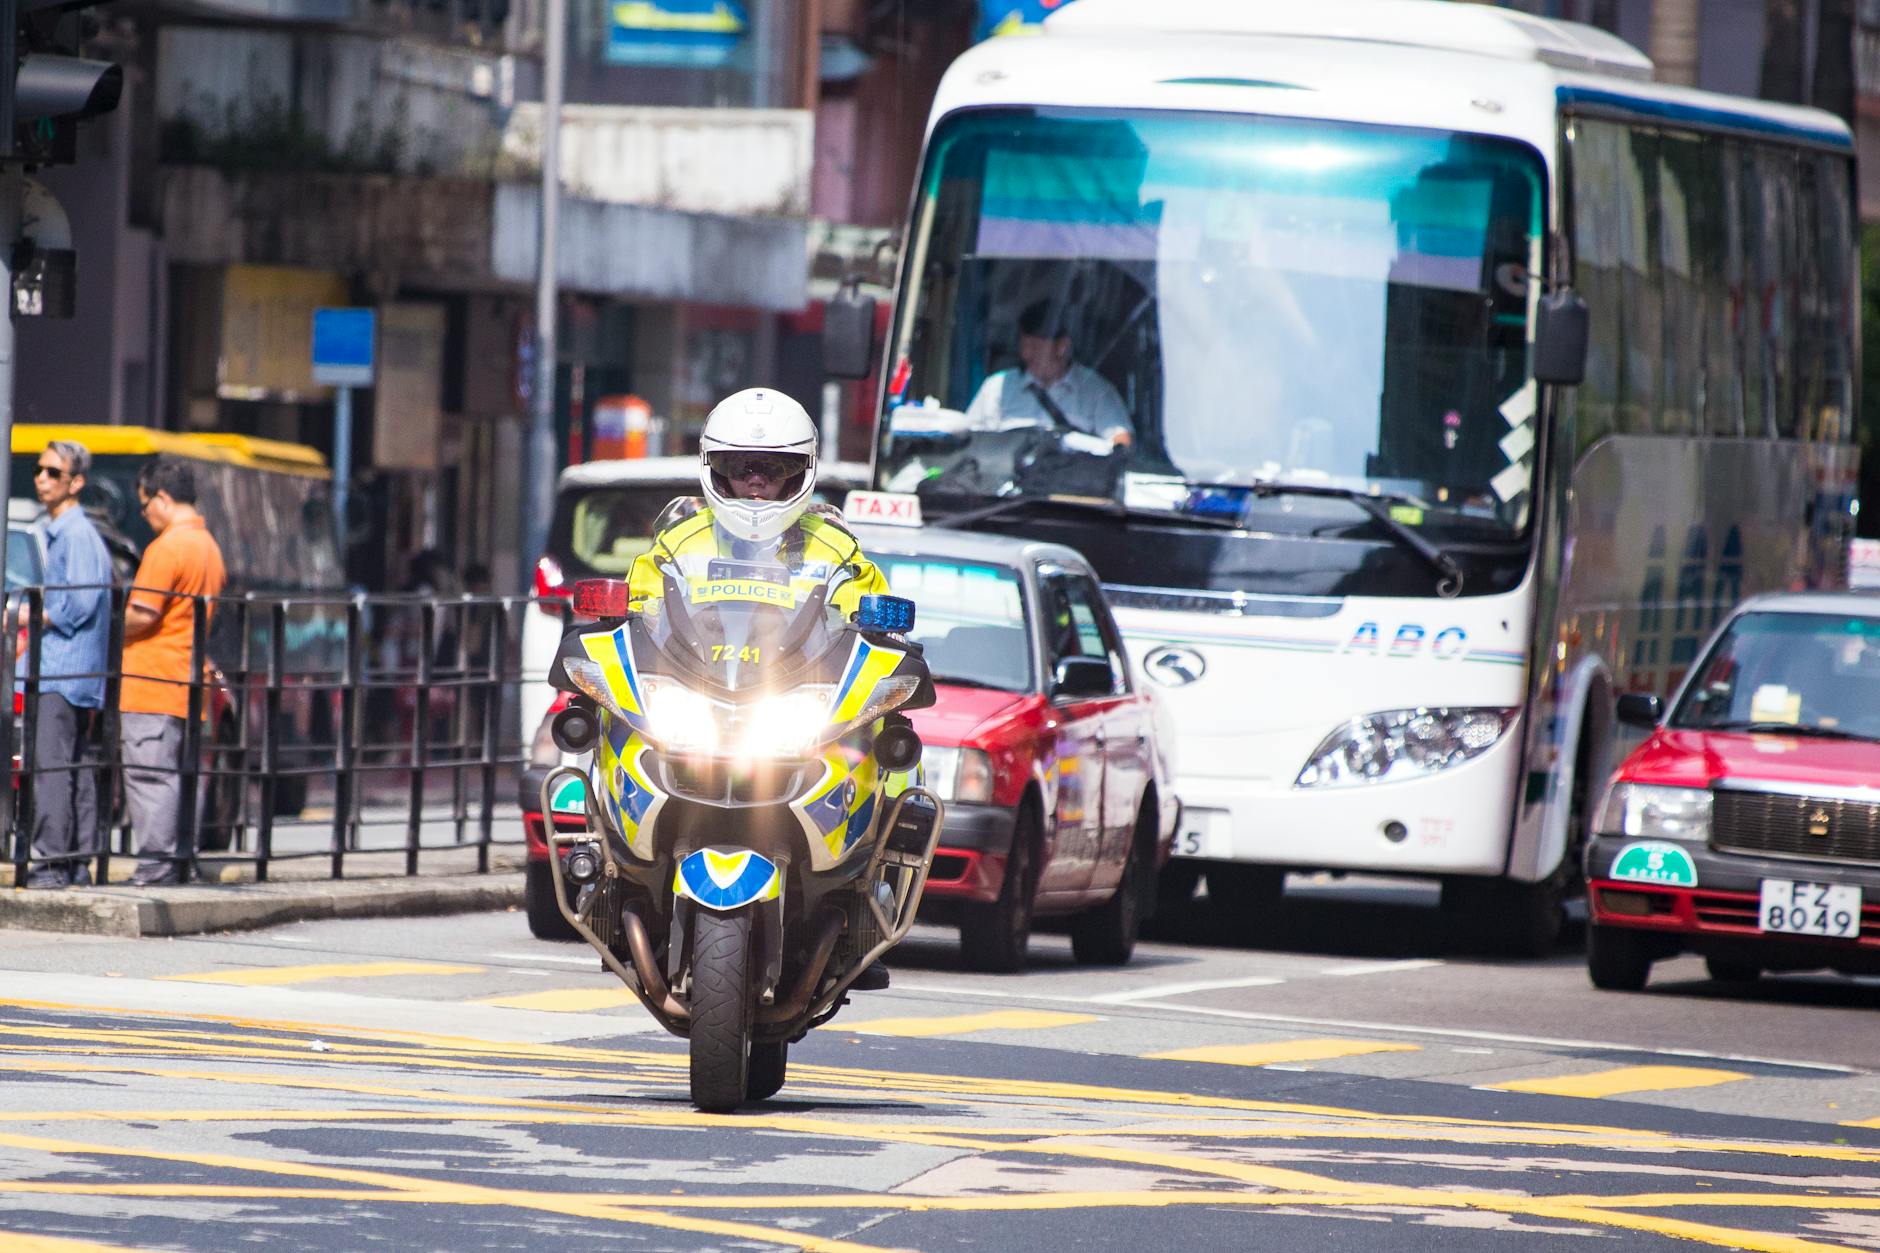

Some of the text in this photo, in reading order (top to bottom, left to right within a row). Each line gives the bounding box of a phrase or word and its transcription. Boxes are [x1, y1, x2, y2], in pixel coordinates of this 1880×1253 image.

[853, 497, 914, 517] TAXI
[710, 584, 778, 599] POLICE
[1342, 622, 1467, 660] ABC
[711, 645, 761, 664] 7241
[1791, 881, 1831, 908] FZ
[1768, 906, 1852, 936] 8049
